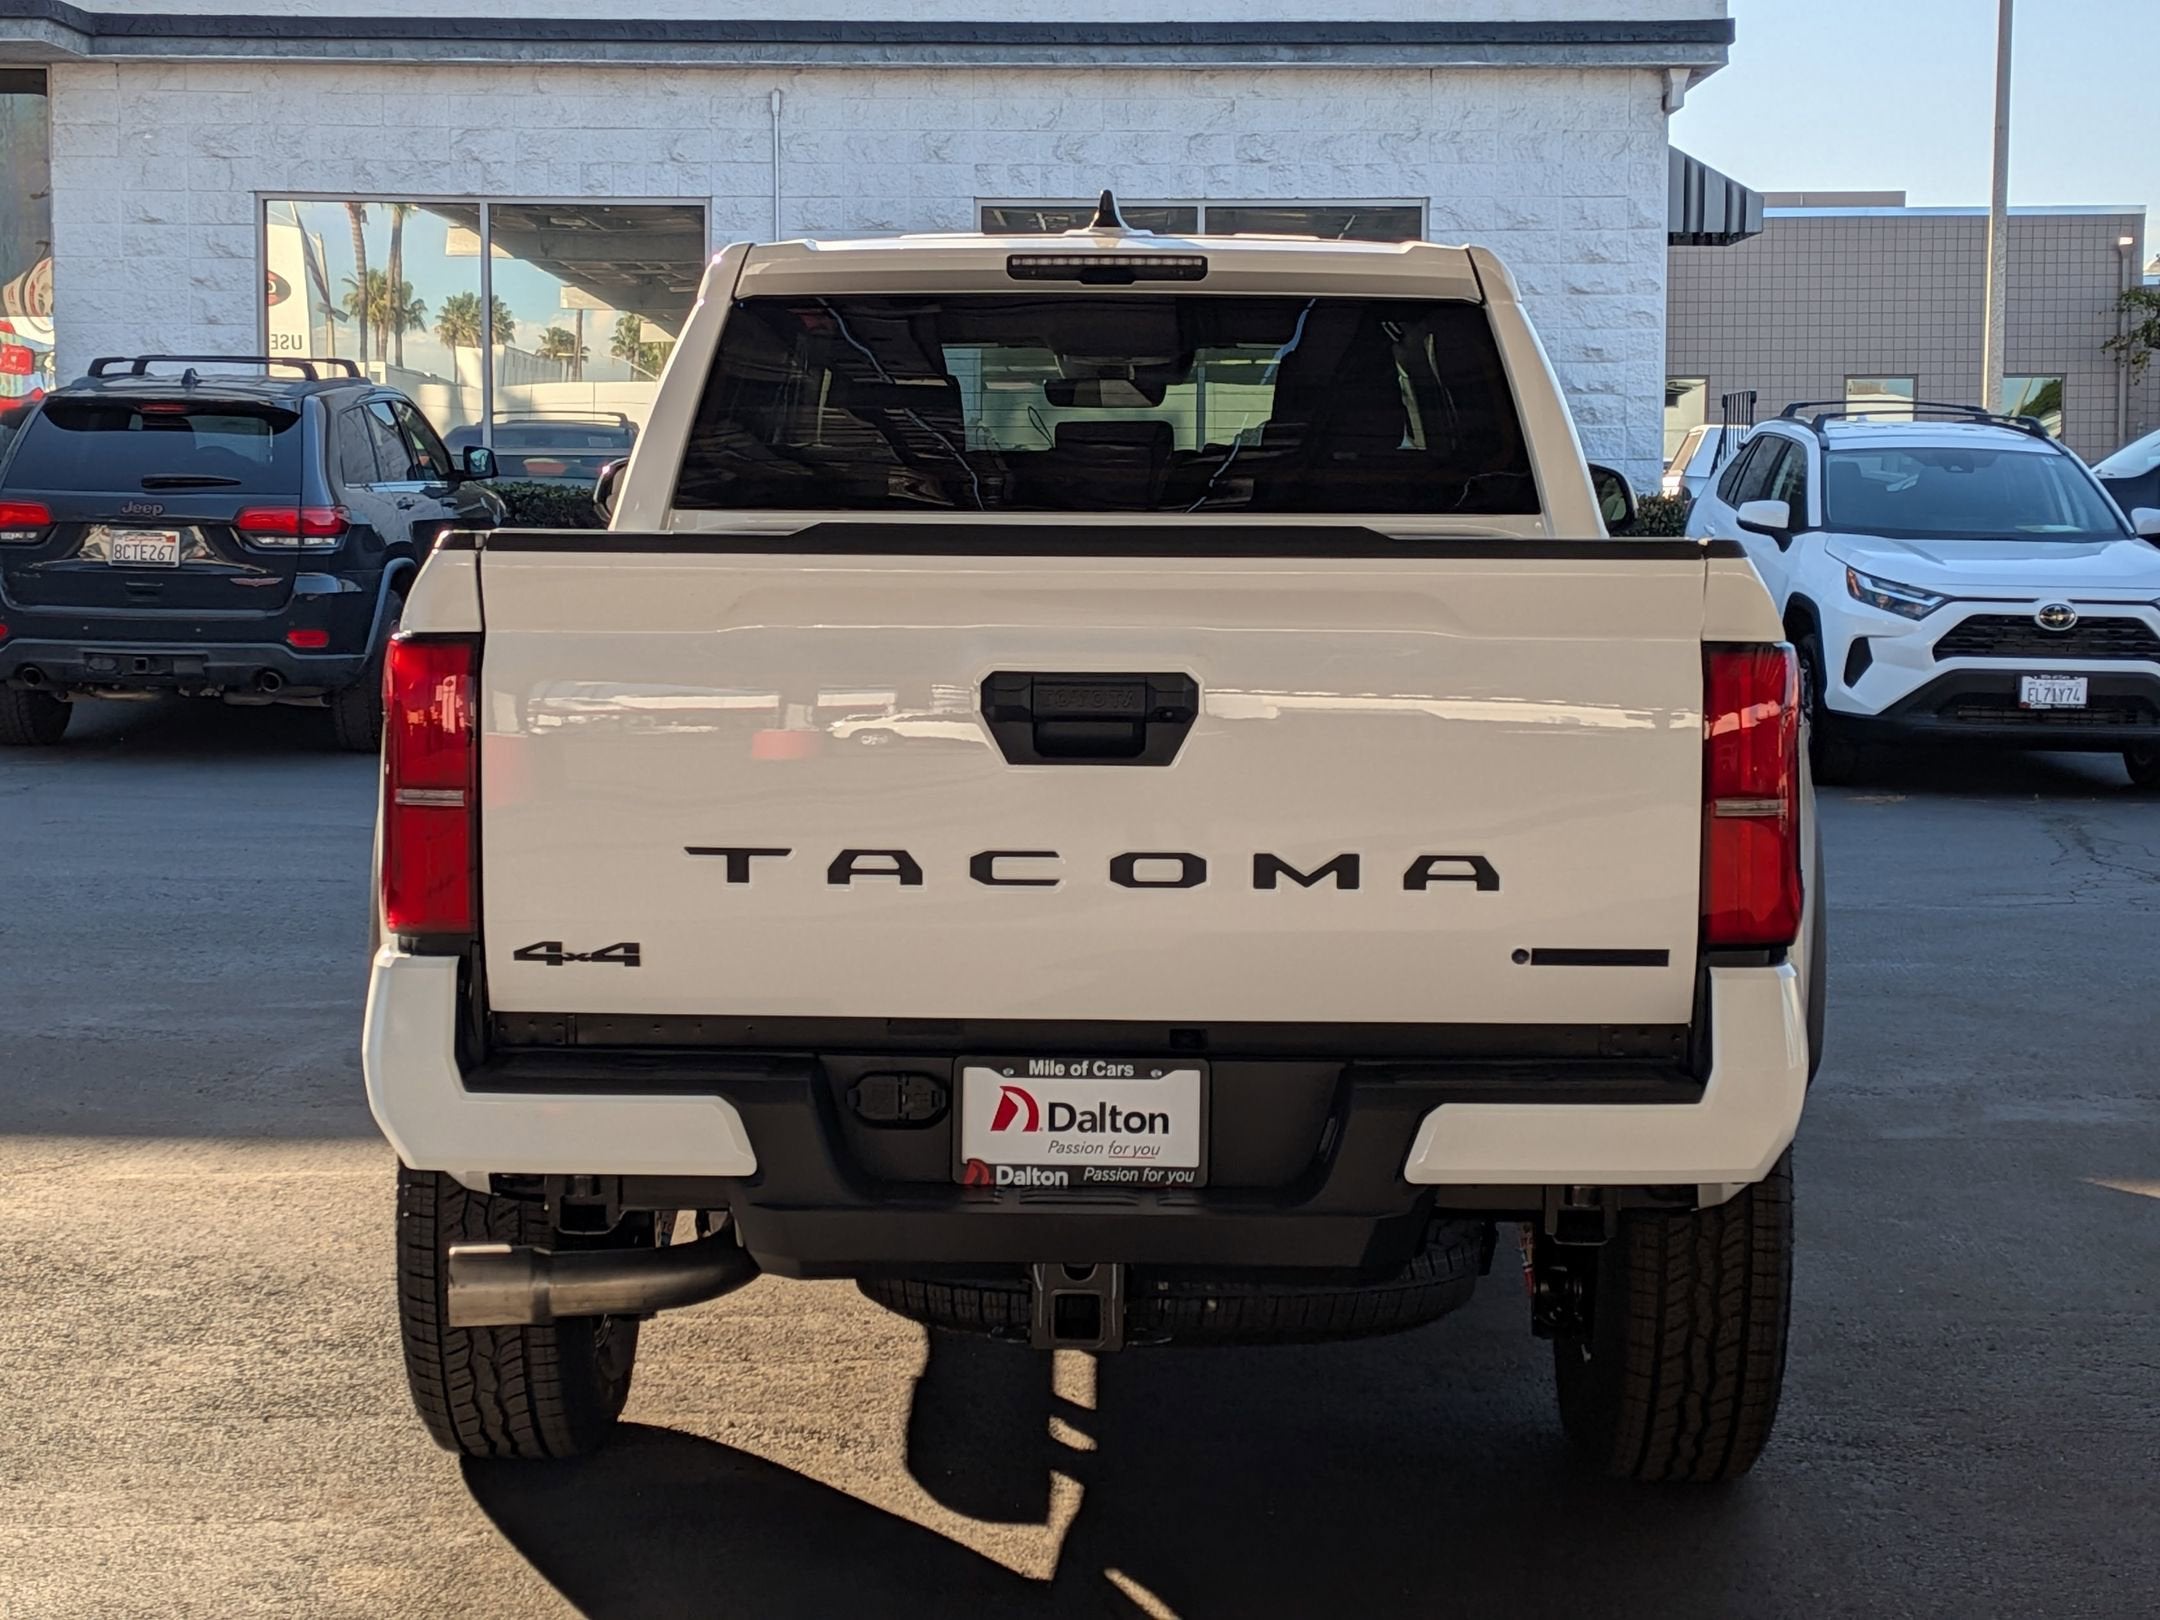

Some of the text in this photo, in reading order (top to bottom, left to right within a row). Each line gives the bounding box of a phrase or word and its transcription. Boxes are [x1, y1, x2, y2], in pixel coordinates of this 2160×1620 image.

[121, 500, 164, 516] Jeep
[114, 543, 175, 561] 8CTE267
[1039, 689, 1138, 708] TOYOTA
[684, 846, 1500, 892] TACOMA
[513, 940, 641, 968] 4x4
[1028, 1059, 1135, 1078] Mile of Cars
[1047, 1101, 1170, 1135] Dalton
[1047, 1140, 1161, 1158] Passion for you
[995, 1165, 1195, 1187] Dalton Passion for you
